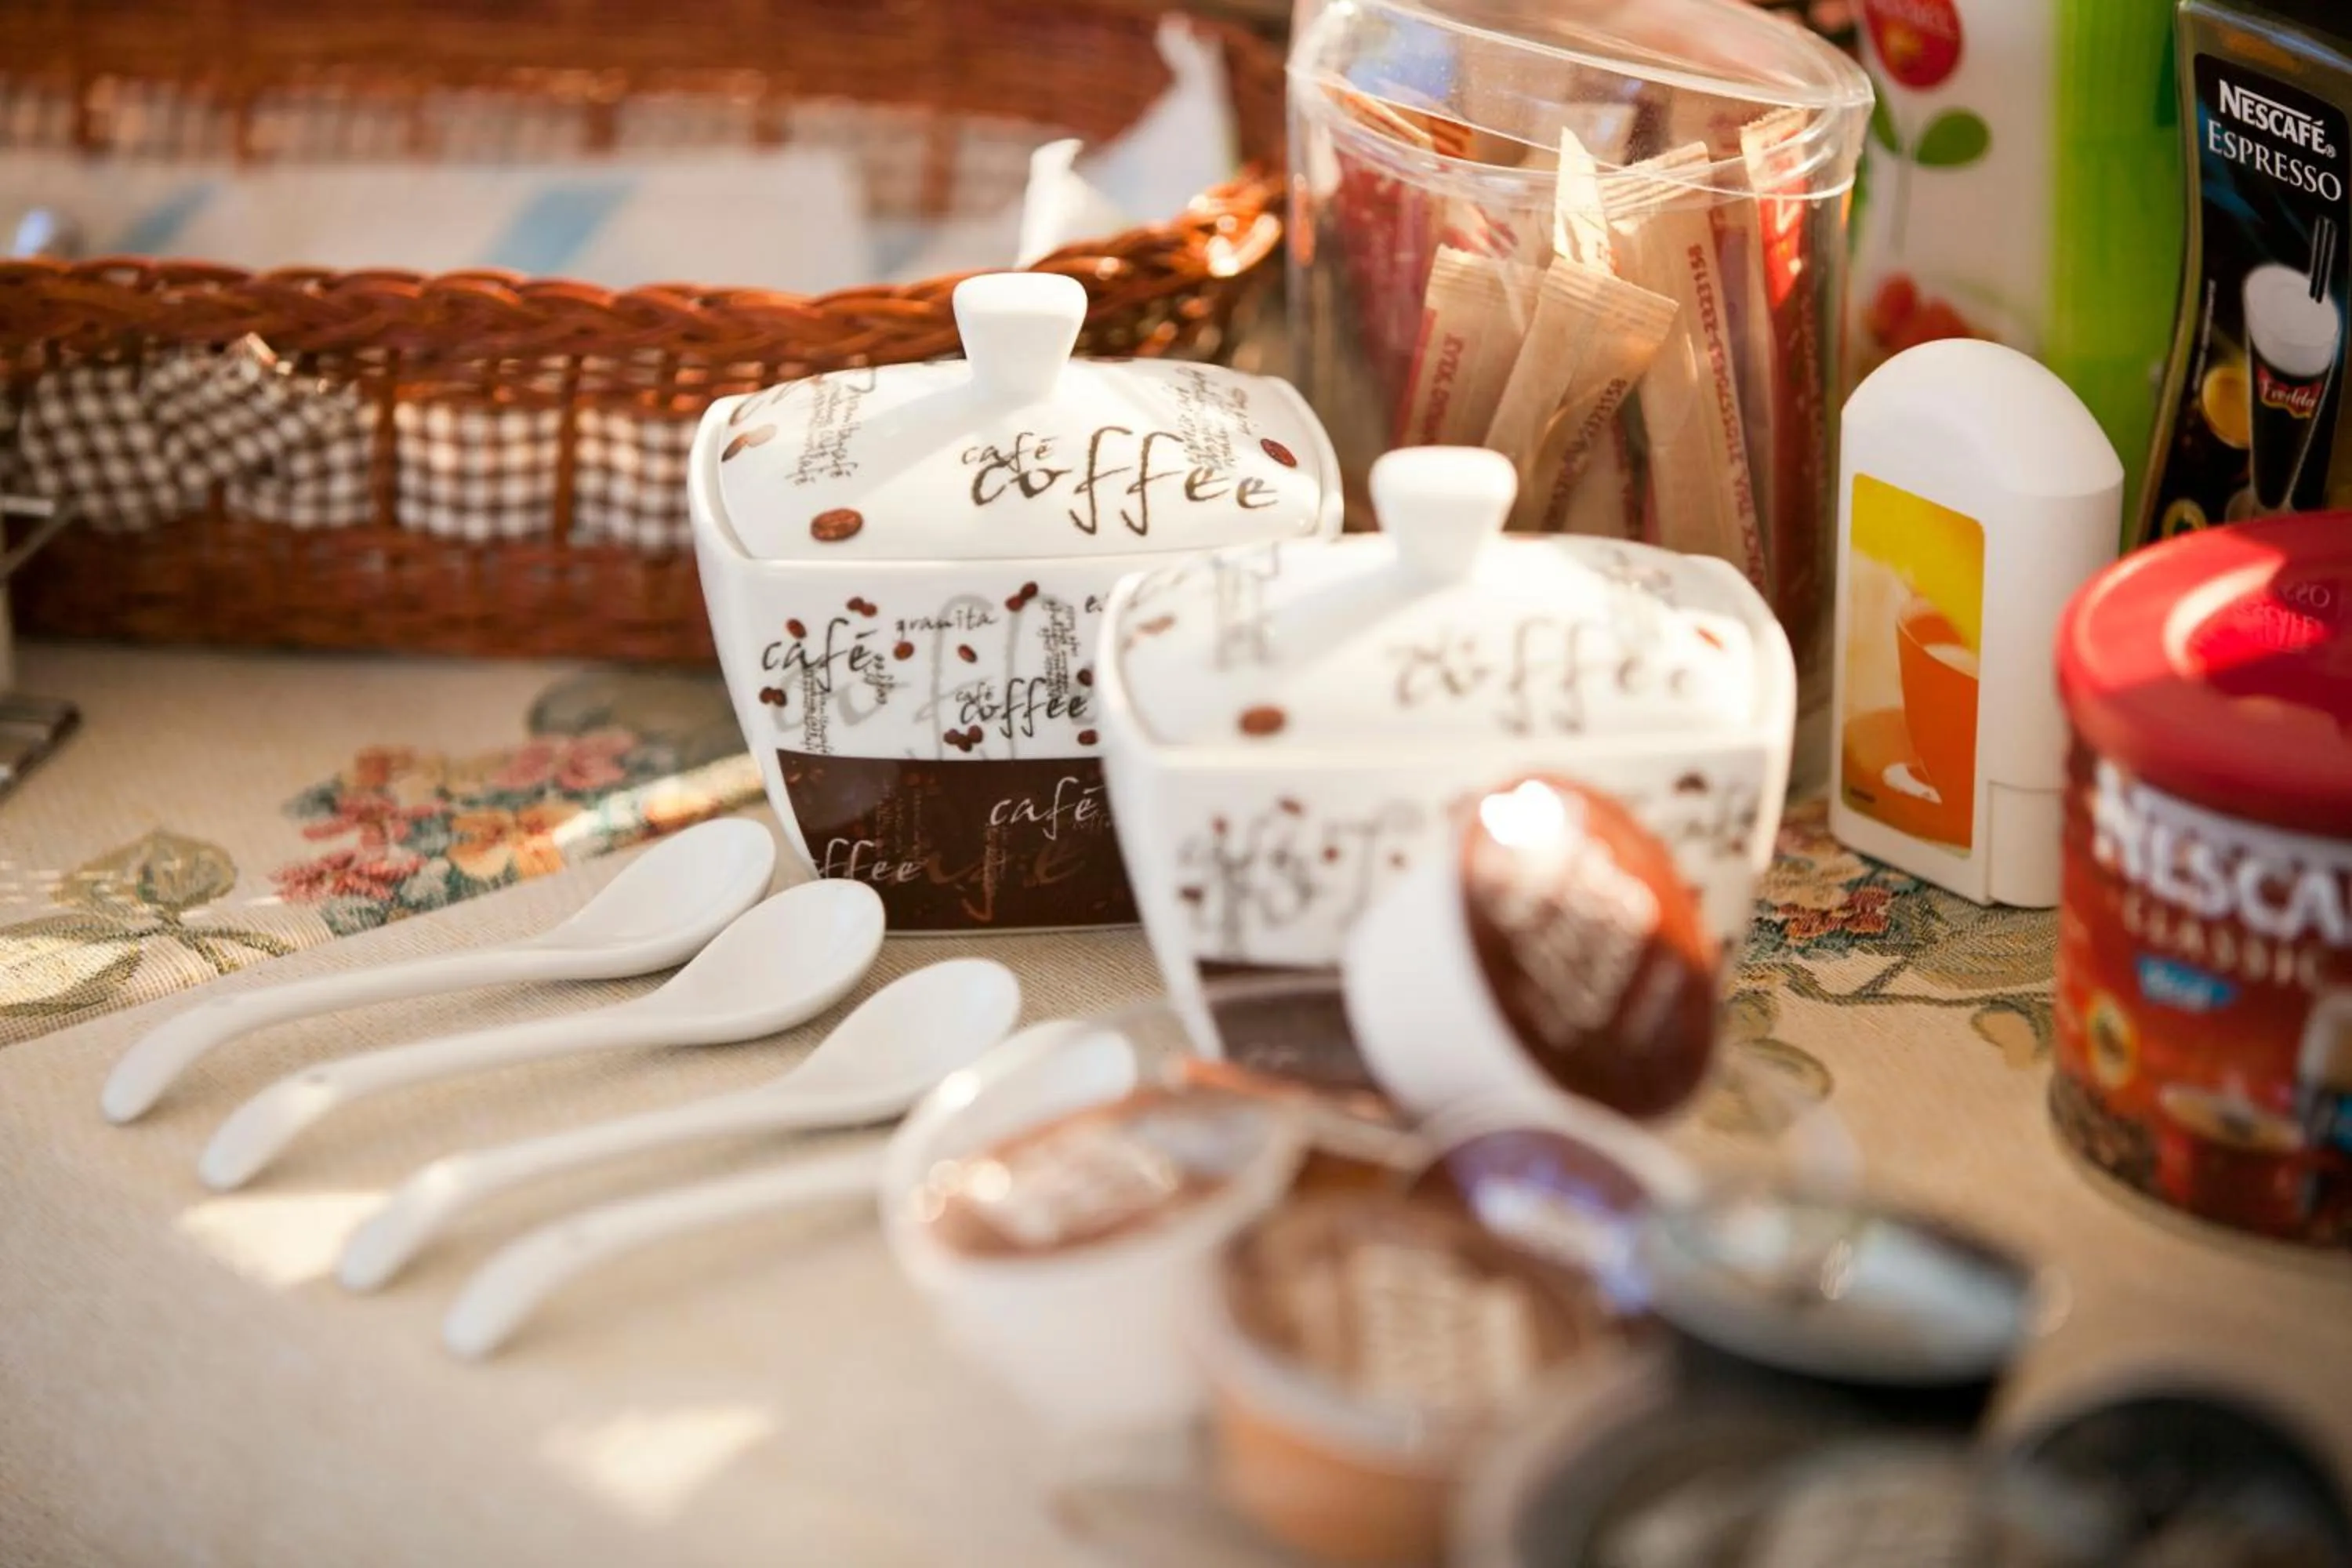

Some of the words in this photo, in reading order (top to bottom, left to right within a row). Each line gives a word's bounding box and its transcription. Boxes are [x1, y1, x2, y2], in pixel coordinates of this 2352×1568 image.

[2208, 119, 2342, 202] ESPRESSO
[961, 431, 1058, 470] café
[971, 426, 1280, 535] coffee
[761, 617, 878, 693] café
[960, 677, 1088, 739] coffee
[989, 776, 1105, 841] café
[817, 837, 923, 883] ffee
[2091, 764, 2352, 946] NESCA
